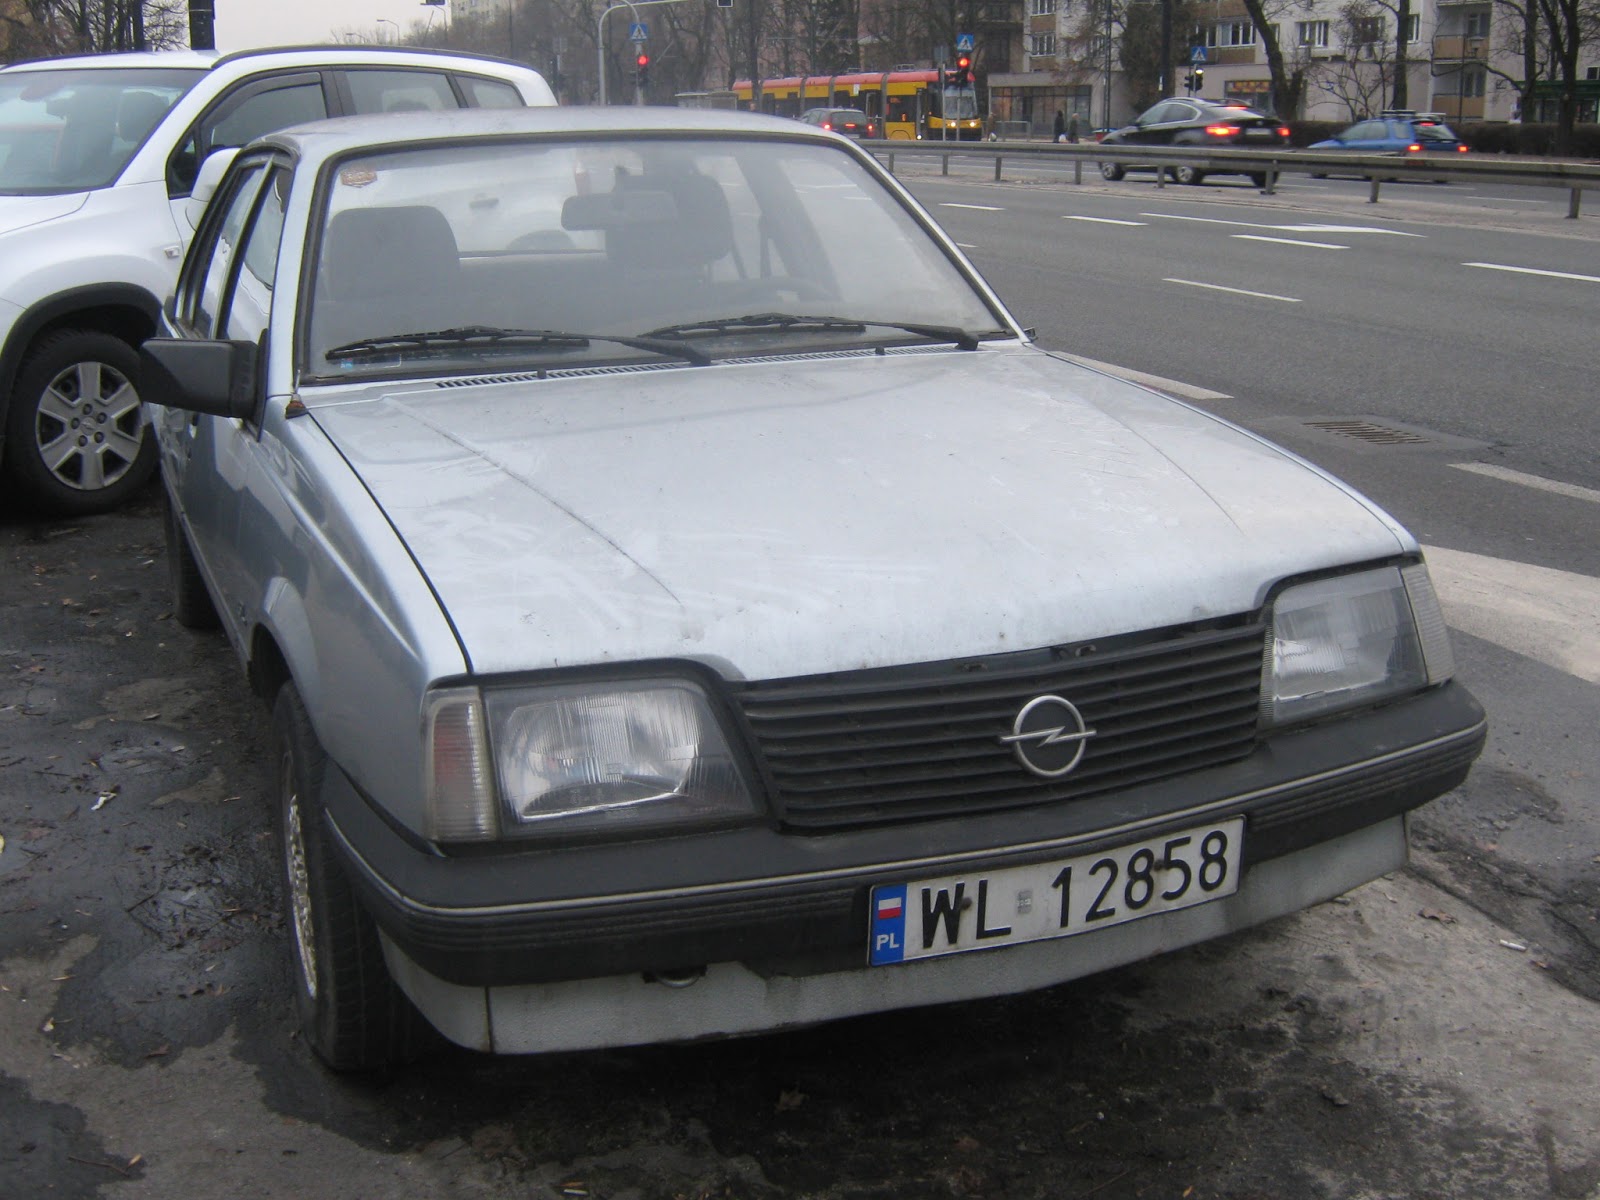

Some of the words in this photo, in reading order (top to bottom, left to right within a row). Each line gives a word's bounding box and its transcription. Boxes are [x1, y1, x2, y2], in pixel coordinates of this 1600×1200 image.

[921, 879, 1012, 949] WL
[1051, 829, 1229, 929] 12858
[876, 933, 900, 952] PL
